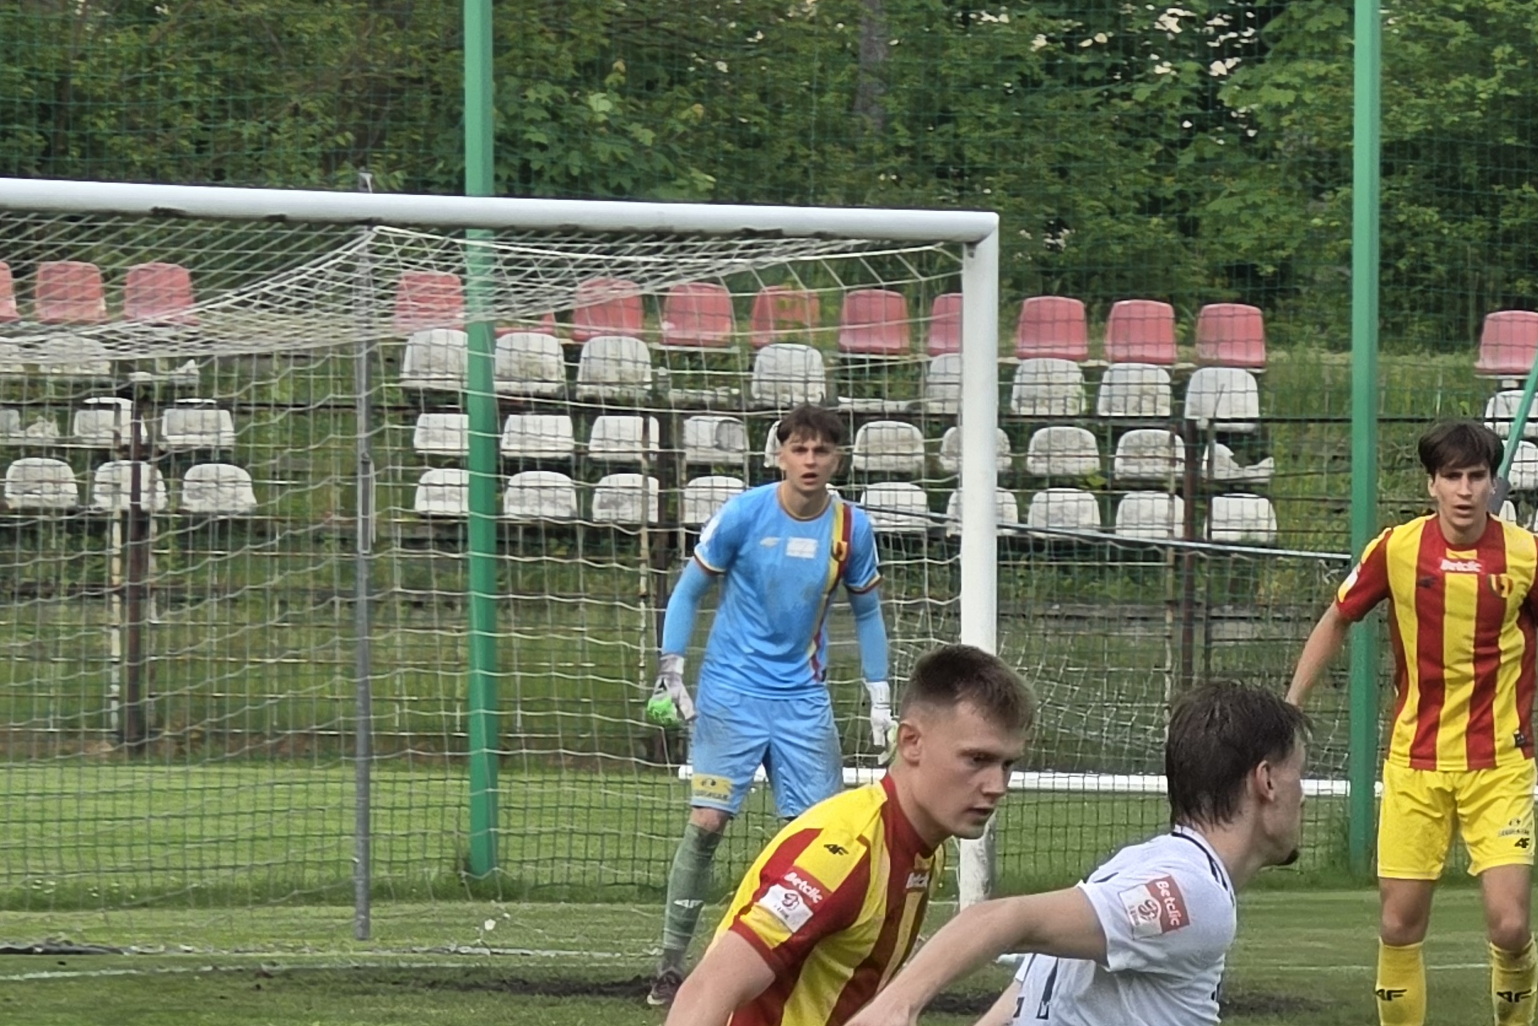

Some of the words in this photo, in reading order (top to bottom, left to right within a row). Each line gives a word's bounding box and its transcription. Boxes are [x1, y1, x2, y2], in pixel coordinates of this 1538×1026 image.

[823, 843, 849, 856] 4F
[783, 871, 824, 904] Betclic
[1155, 880, 1182, 927] Betclic
